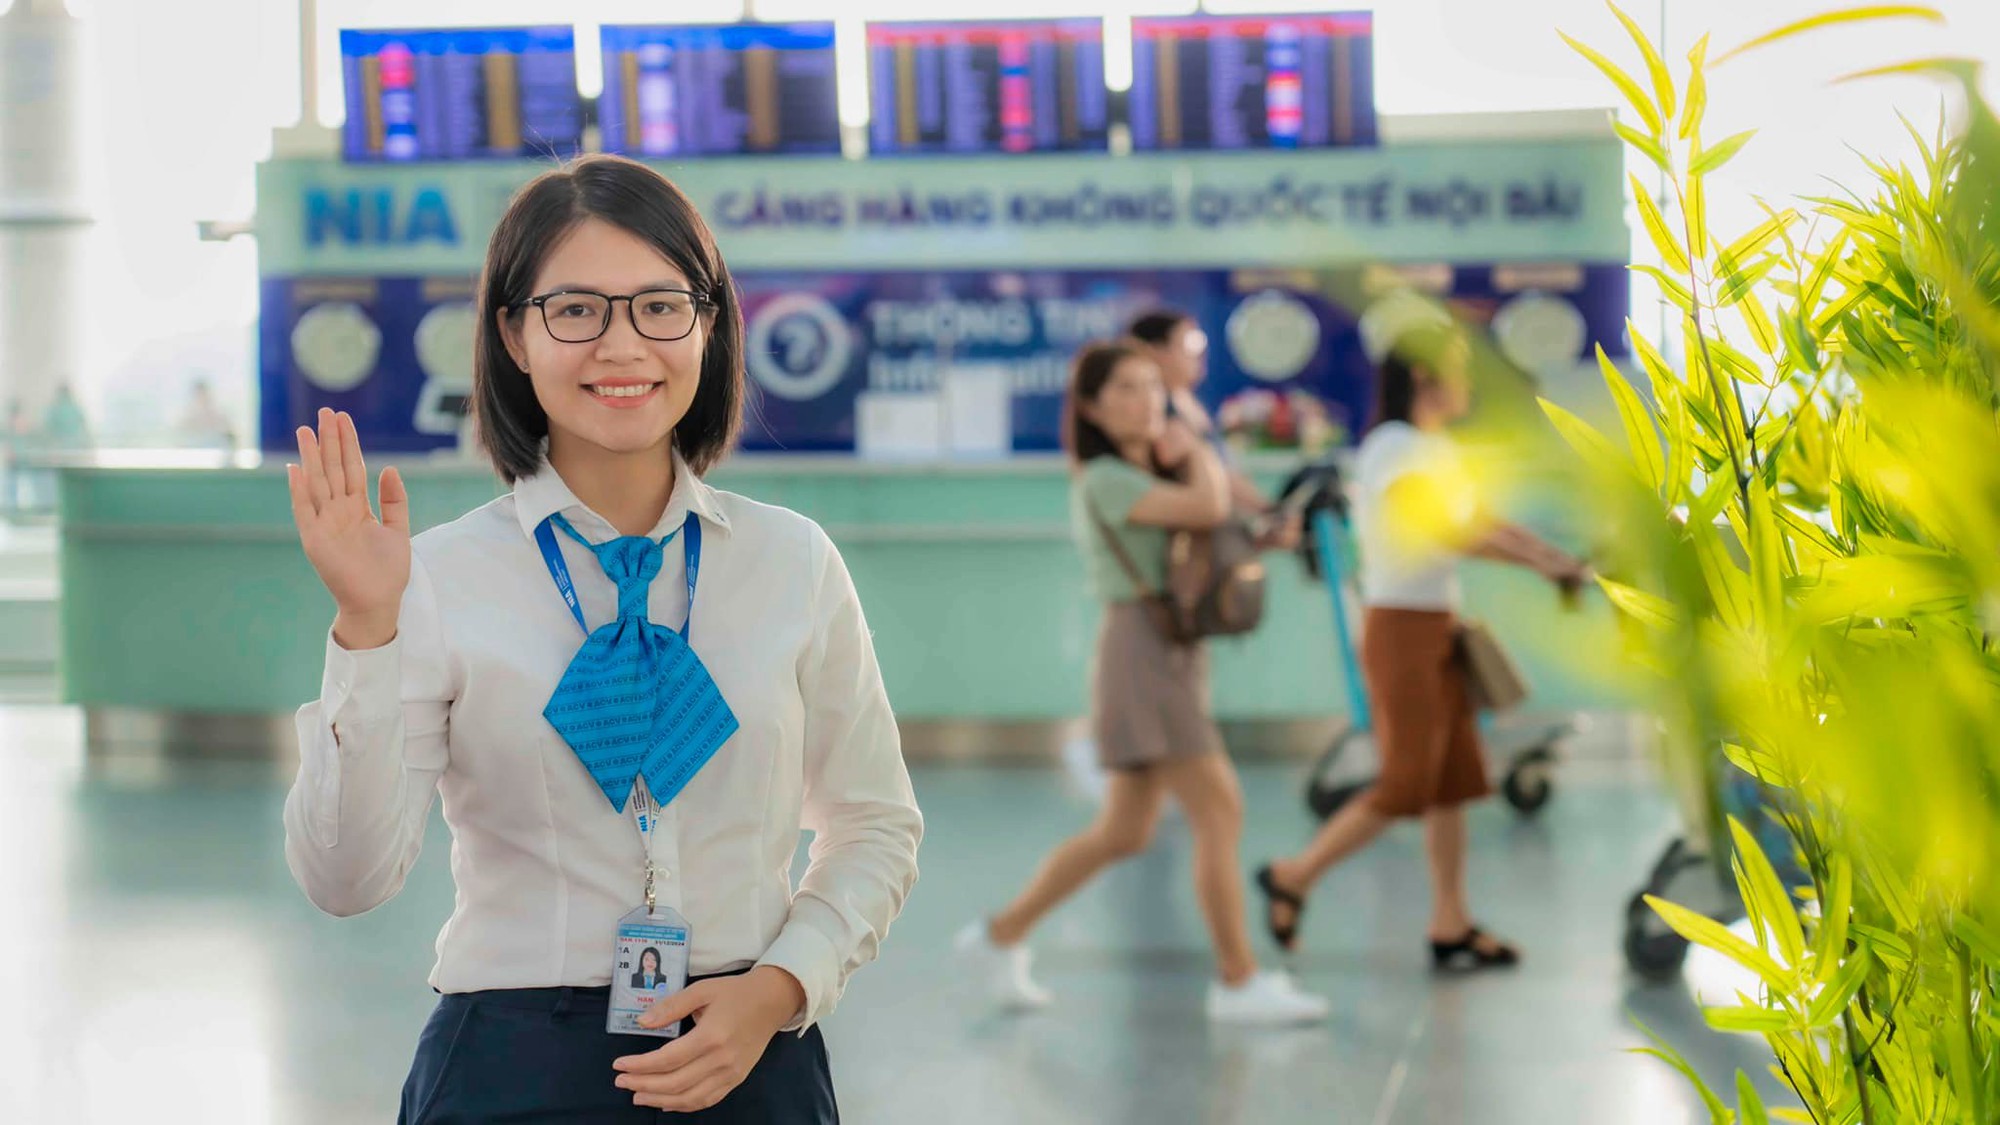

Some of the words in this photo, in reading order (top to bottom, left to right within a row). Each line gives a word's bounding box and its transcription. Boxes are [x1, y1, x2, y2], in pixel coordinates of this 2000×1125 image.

[1010, 183, 1172, 227] KHÔNG
[1194, 175, 1325, 227] QUỐC
[305, 188, 458, 247] NIA
[568, 701, 585, 711] ACV
[577, 720, 594, 729] ACV
[604, 717, 620, 726] ACV
[586, 740, 603, 749] ACV
[612, 736, 630, 745] ACV
[594, 759, 611, 768] ACV
